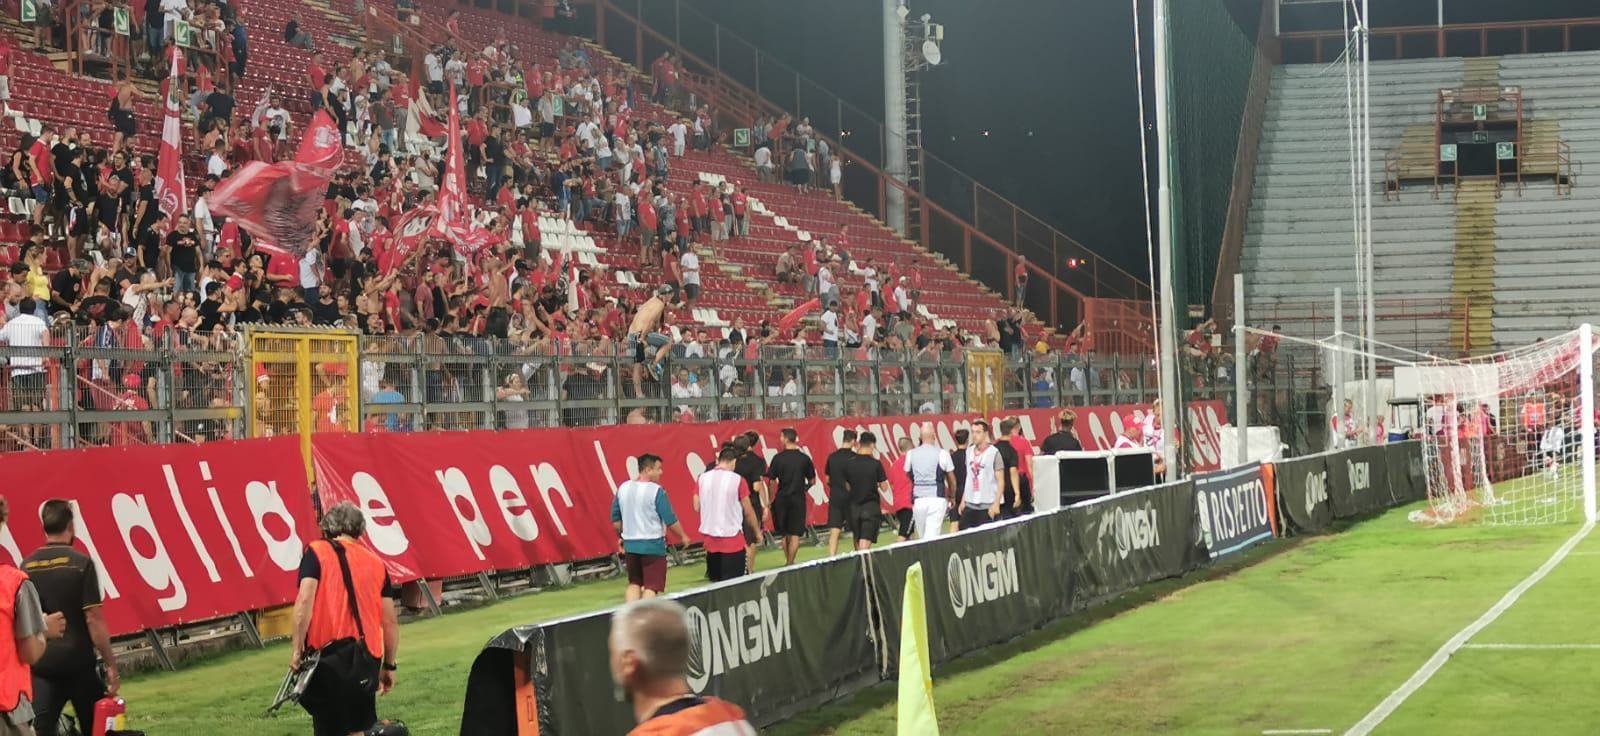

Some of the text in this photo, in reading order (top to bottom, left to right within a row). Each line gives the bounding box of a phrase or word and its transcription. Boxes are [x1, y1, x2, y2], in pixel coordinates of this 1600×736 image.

[351, 471, 409, 556] e
[435, 462, 574, 561] per
[1210, 478, 1268, 542] RISPETTO
[965, 547, 1019, 608] NGM
[708, 591, 792, 676] NGM
